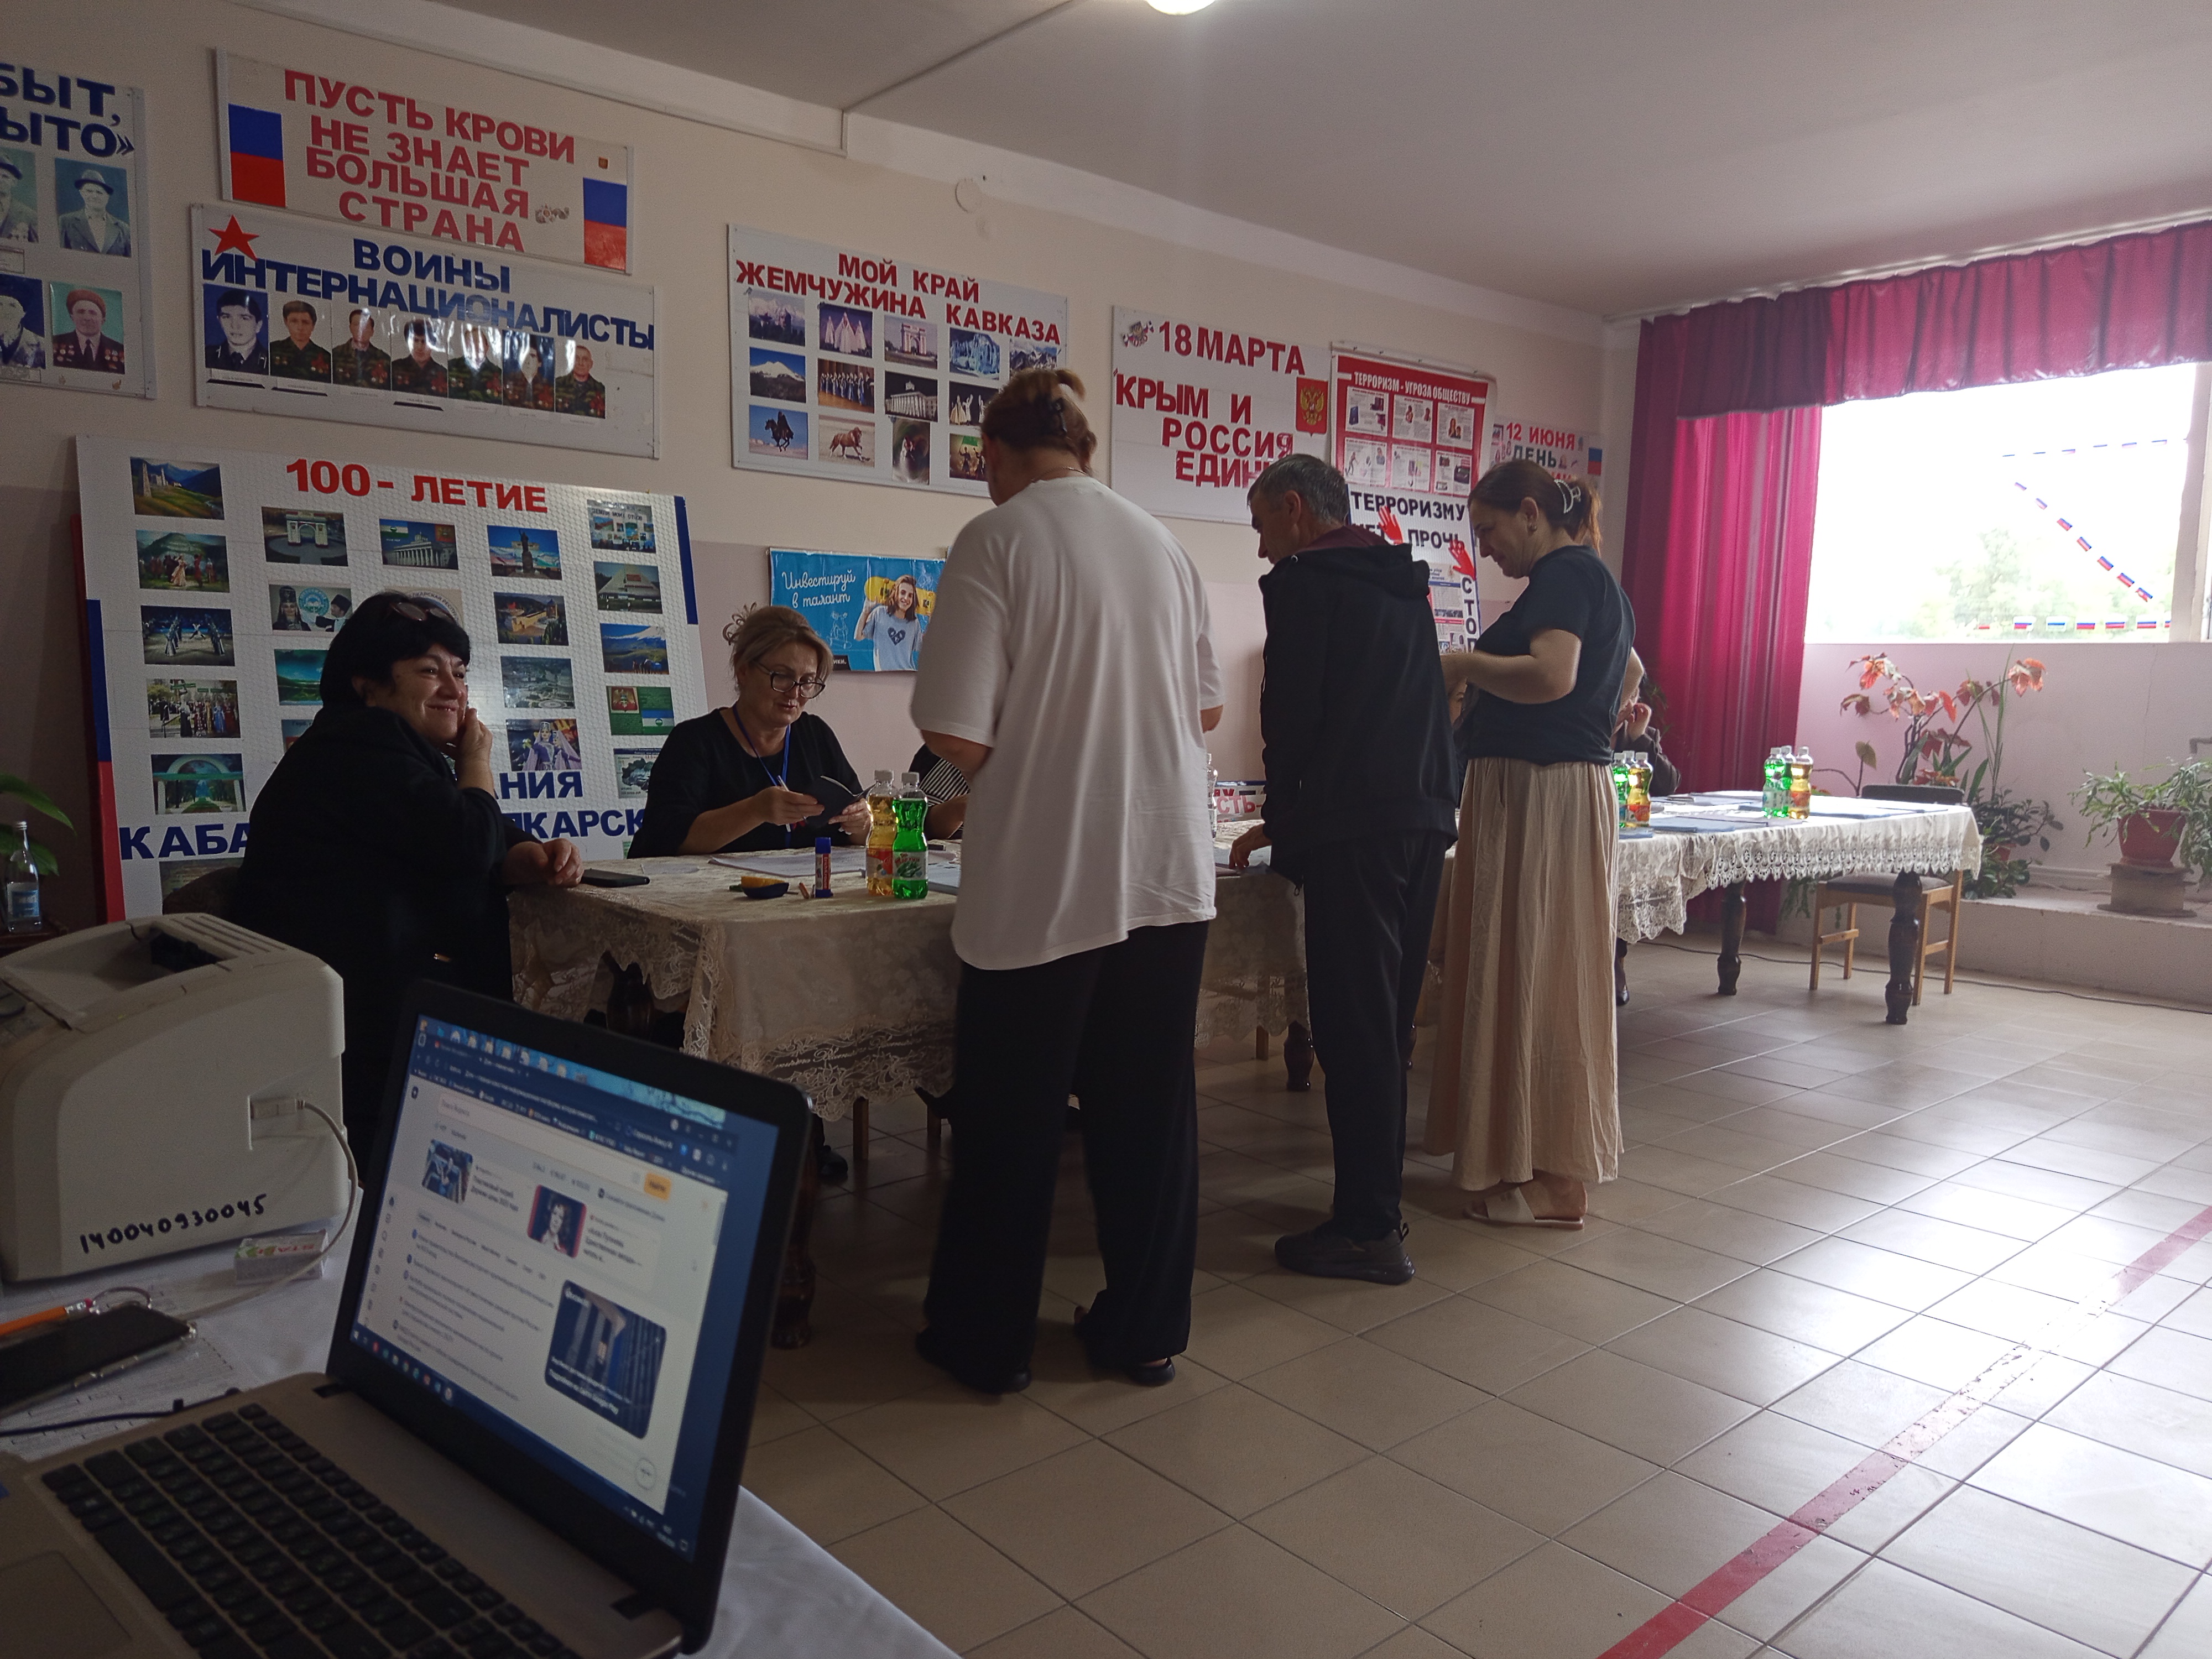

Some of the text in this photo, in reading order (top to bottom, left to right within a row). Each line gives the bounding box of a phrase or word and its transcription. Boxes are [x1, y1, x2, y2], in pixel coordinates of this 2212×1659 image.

[285, 69, 574, 164] ПУСТЬ КРОВИ
[311, 114, 529, 186] НЕ ЗНАЕТ
[306, 146, 529, 219] БОЛЬШАЯ
[339, 191, 525, 252] СТРАНА
[354, 238, 510, 294] ВОИНЫ
[838, 253, 979, 303] МОЙ КРАЙ
[202, 249, 654, 350] ИНТЕРНАЦИОНАЛИСТЫ
[736, 259, 1061, 345] ЖЕМЧУЖИНА КАВКАЗА
[1354, 372, 1399, 392] ТЕРРОРИЗМ
[1405, 381, 1431, 398] УГРОЗА
[1433, 387, 1470, 405] ОБЩЕСТВУ
[1230, 394, 1251, 425] И
[1162, 417, 1293, 460] РОССИЯ
[1506, 422, 1575, 450] 12 ИЮНЯ
[1176, 450, 1272, 488] ЕДИН
[411, 475, 547, 513] ЛЕТИЕ
[1350, 492, 1464, 521] ТЕРРОРИЗМУ
[782, 570, 856, 592] Инвестируй
[792, 592, 851, 608] в талант
[494, 771, 583, 800] НИЯ
[119, 822, 250, 860] КАБА
[80, 1193, 267, 1254] 140040930045
